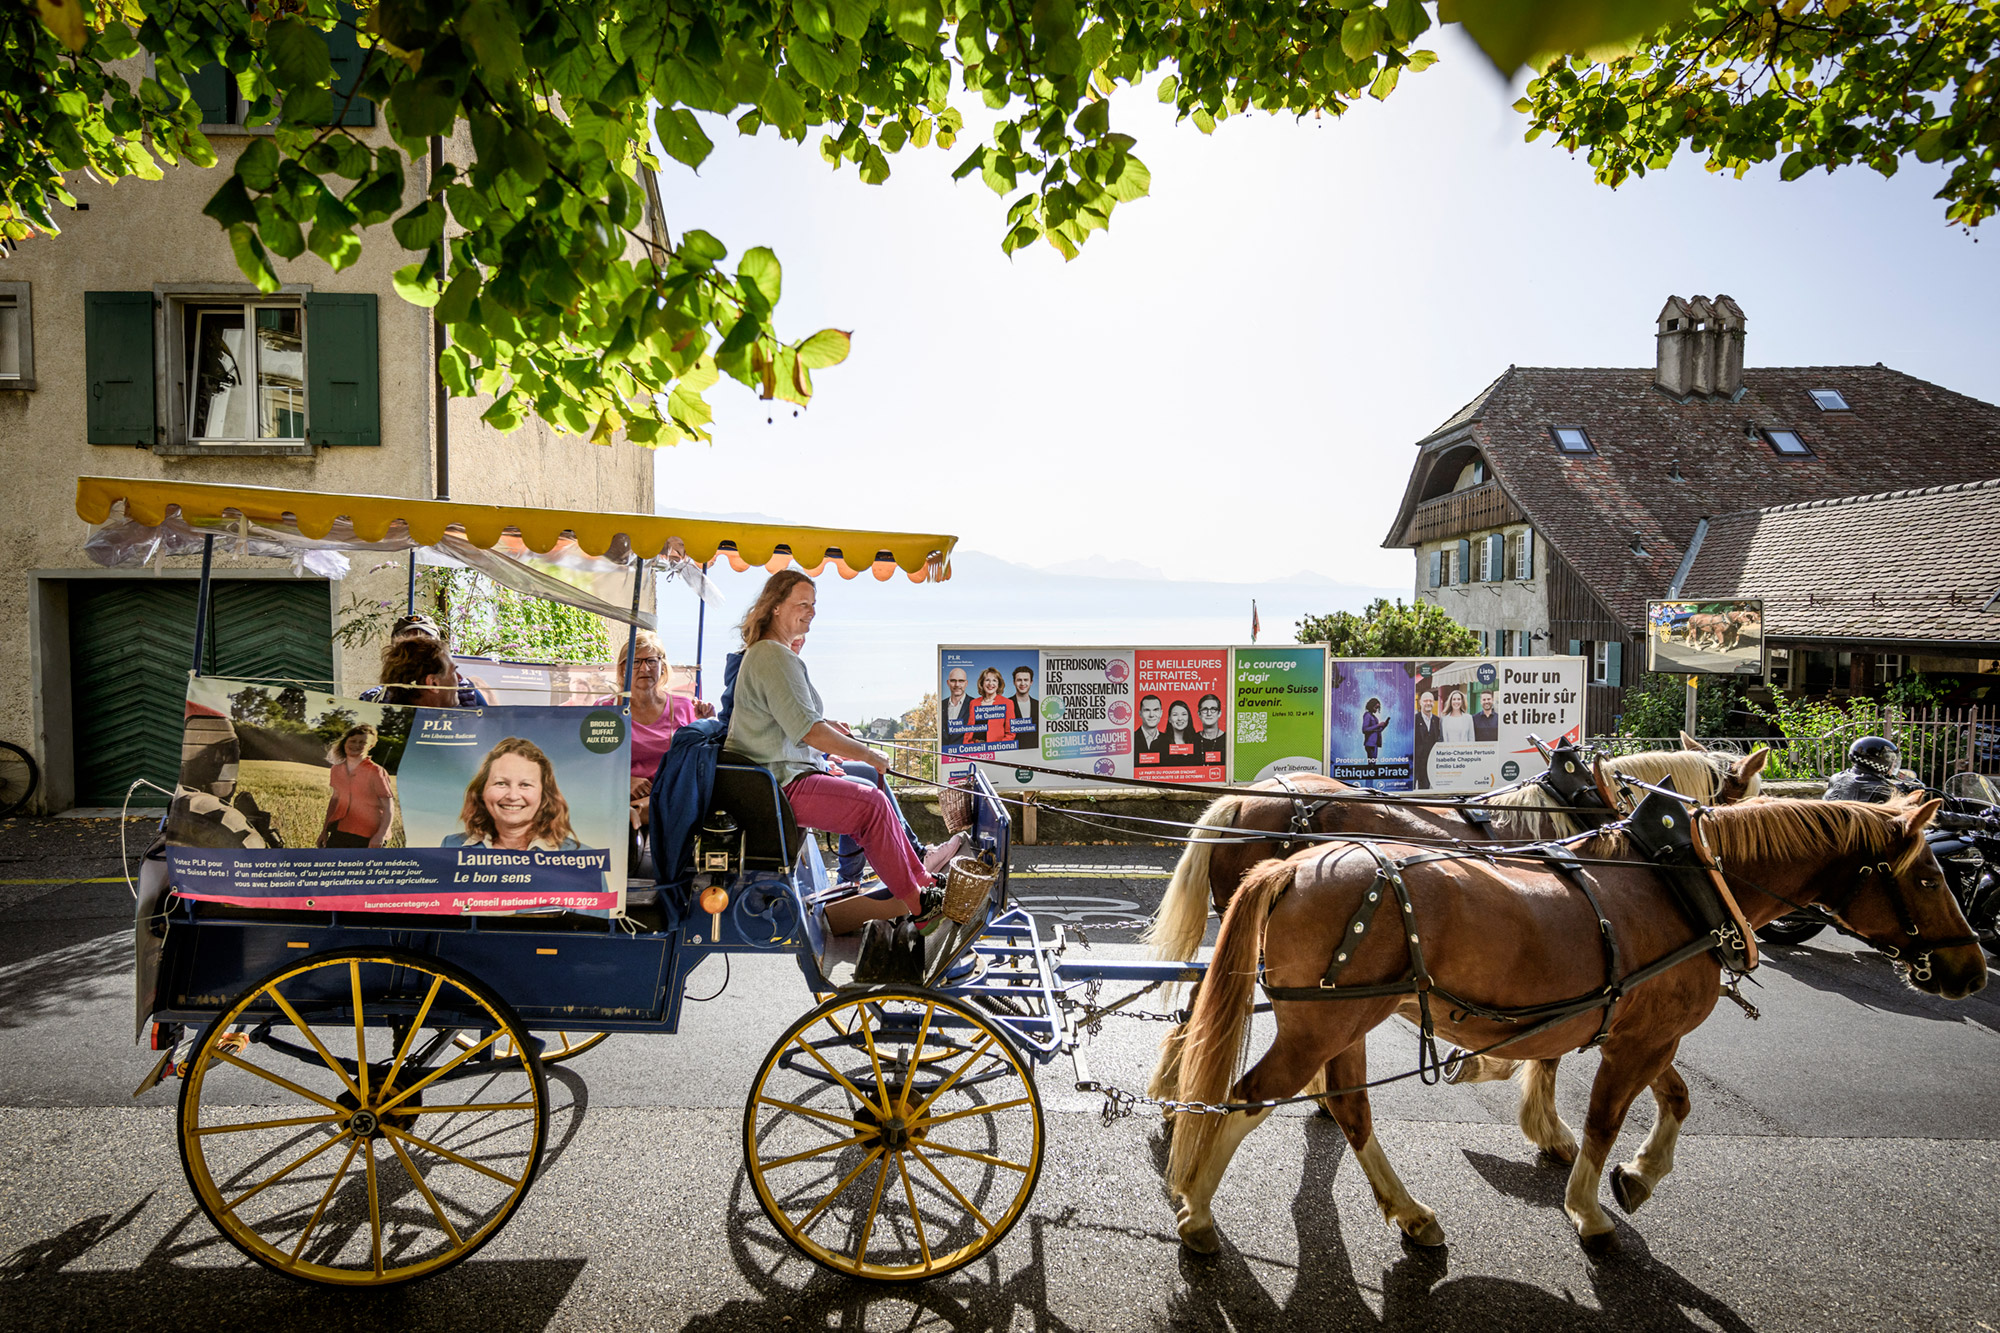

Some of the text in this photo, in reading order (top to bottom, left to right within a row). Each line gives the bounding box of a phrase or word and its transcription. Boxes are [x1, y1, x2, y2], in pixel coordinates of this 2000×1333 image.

[1047, 659, 1106, 670] INTERDISONS
[1140, 660, 1222, 669] DE MEILLEURES
[1238, 660, 1297, 671] Le courage
[1047, 672, 1062, 683] LES
[1140, 671, 1201, 681] RETRAITES,
[1238, 672, 1270, 684] d'agir
[1504, 669, 1560, 684] Pour un
[1047, 683, 1128, 695] INVESTISSEMENTS
[1139, 682, 1210, 691] MAINTENANT
[1238, 684, 1318, 697] pour une Suisse
[1063, 696, 1106, 707] DANS LES
[1503, 688, 1576, 704] avenir sûr
[1238, 698, 1282, 707] d'avenir.
[1063, 708, 1106, 719] ENERGIES
[1503, 709, 1564, 724] et libre !
[422, 720, 452, 730] PLR
[1047, 721, 1088, 732] FOSSILES
[600, 735, 619, 743] ÉTATS
[1045, 732, 1127, 748] ENSEMBLE A GAUCHE
[960, 744, 986, 752] Conseil
[988, 742, 1017, 751] national
[1335, 766, 1409, 779] Éthique Pirate
[174, 857, 190, 866] Votez
[384, 860, 420, 868] médecin,
[457, 850, 605, 870] Laurence Cretegny
[235, 870, 249, 878] d'un
[251, 870, 298, 878] mécanicien,
[319, 869, 345, 878] juriste
[391, 869, 405, 877] par
[453, 872, 532, 883] Le bon sens
[297, 879, 318, 887] d'une
[320, 879, 364, 887] agricultrice
[364, 900, 440, 908] laurencecretegny.ch
[452, 898, 463, 907] Au
[467, 897, 498, 907] Conseil
[501, 897, 537, 906] national
[550, 896, 598, 906] 22.10.2023
